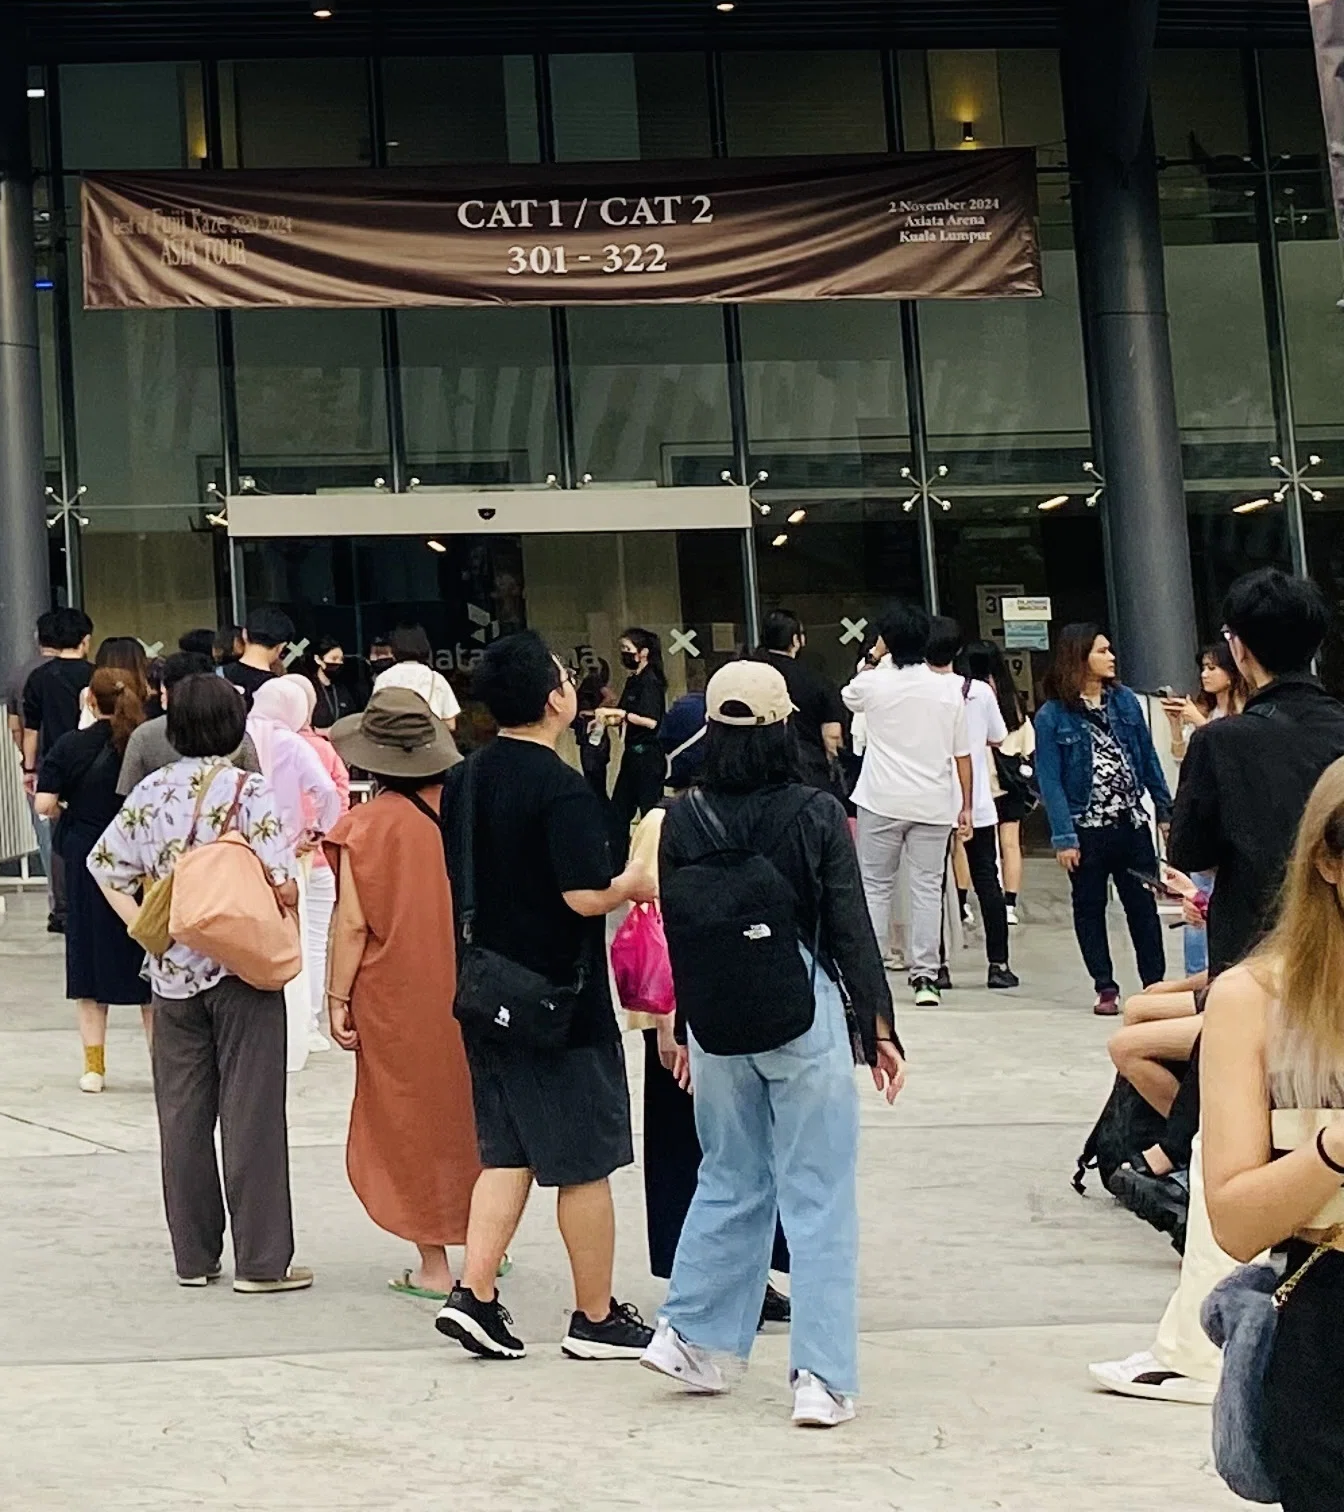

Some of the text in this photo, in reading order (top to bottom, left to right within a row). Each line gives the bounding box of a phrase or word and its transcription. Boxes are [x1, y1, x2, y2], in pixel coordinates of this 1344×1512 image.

[458, 195, 713, 228] CAT 1 / CAT 2
[888, 198, 1000, 213] 2 November 2024
[905, 214, 985, 227] Axiata Arena
[899, 230, 992, 244] Kuala Lumpur
[162, 238, 246, 265] ASIA TOUR
[507, 246, 568, 274] 301
[602, 244, 667, 273] 322
